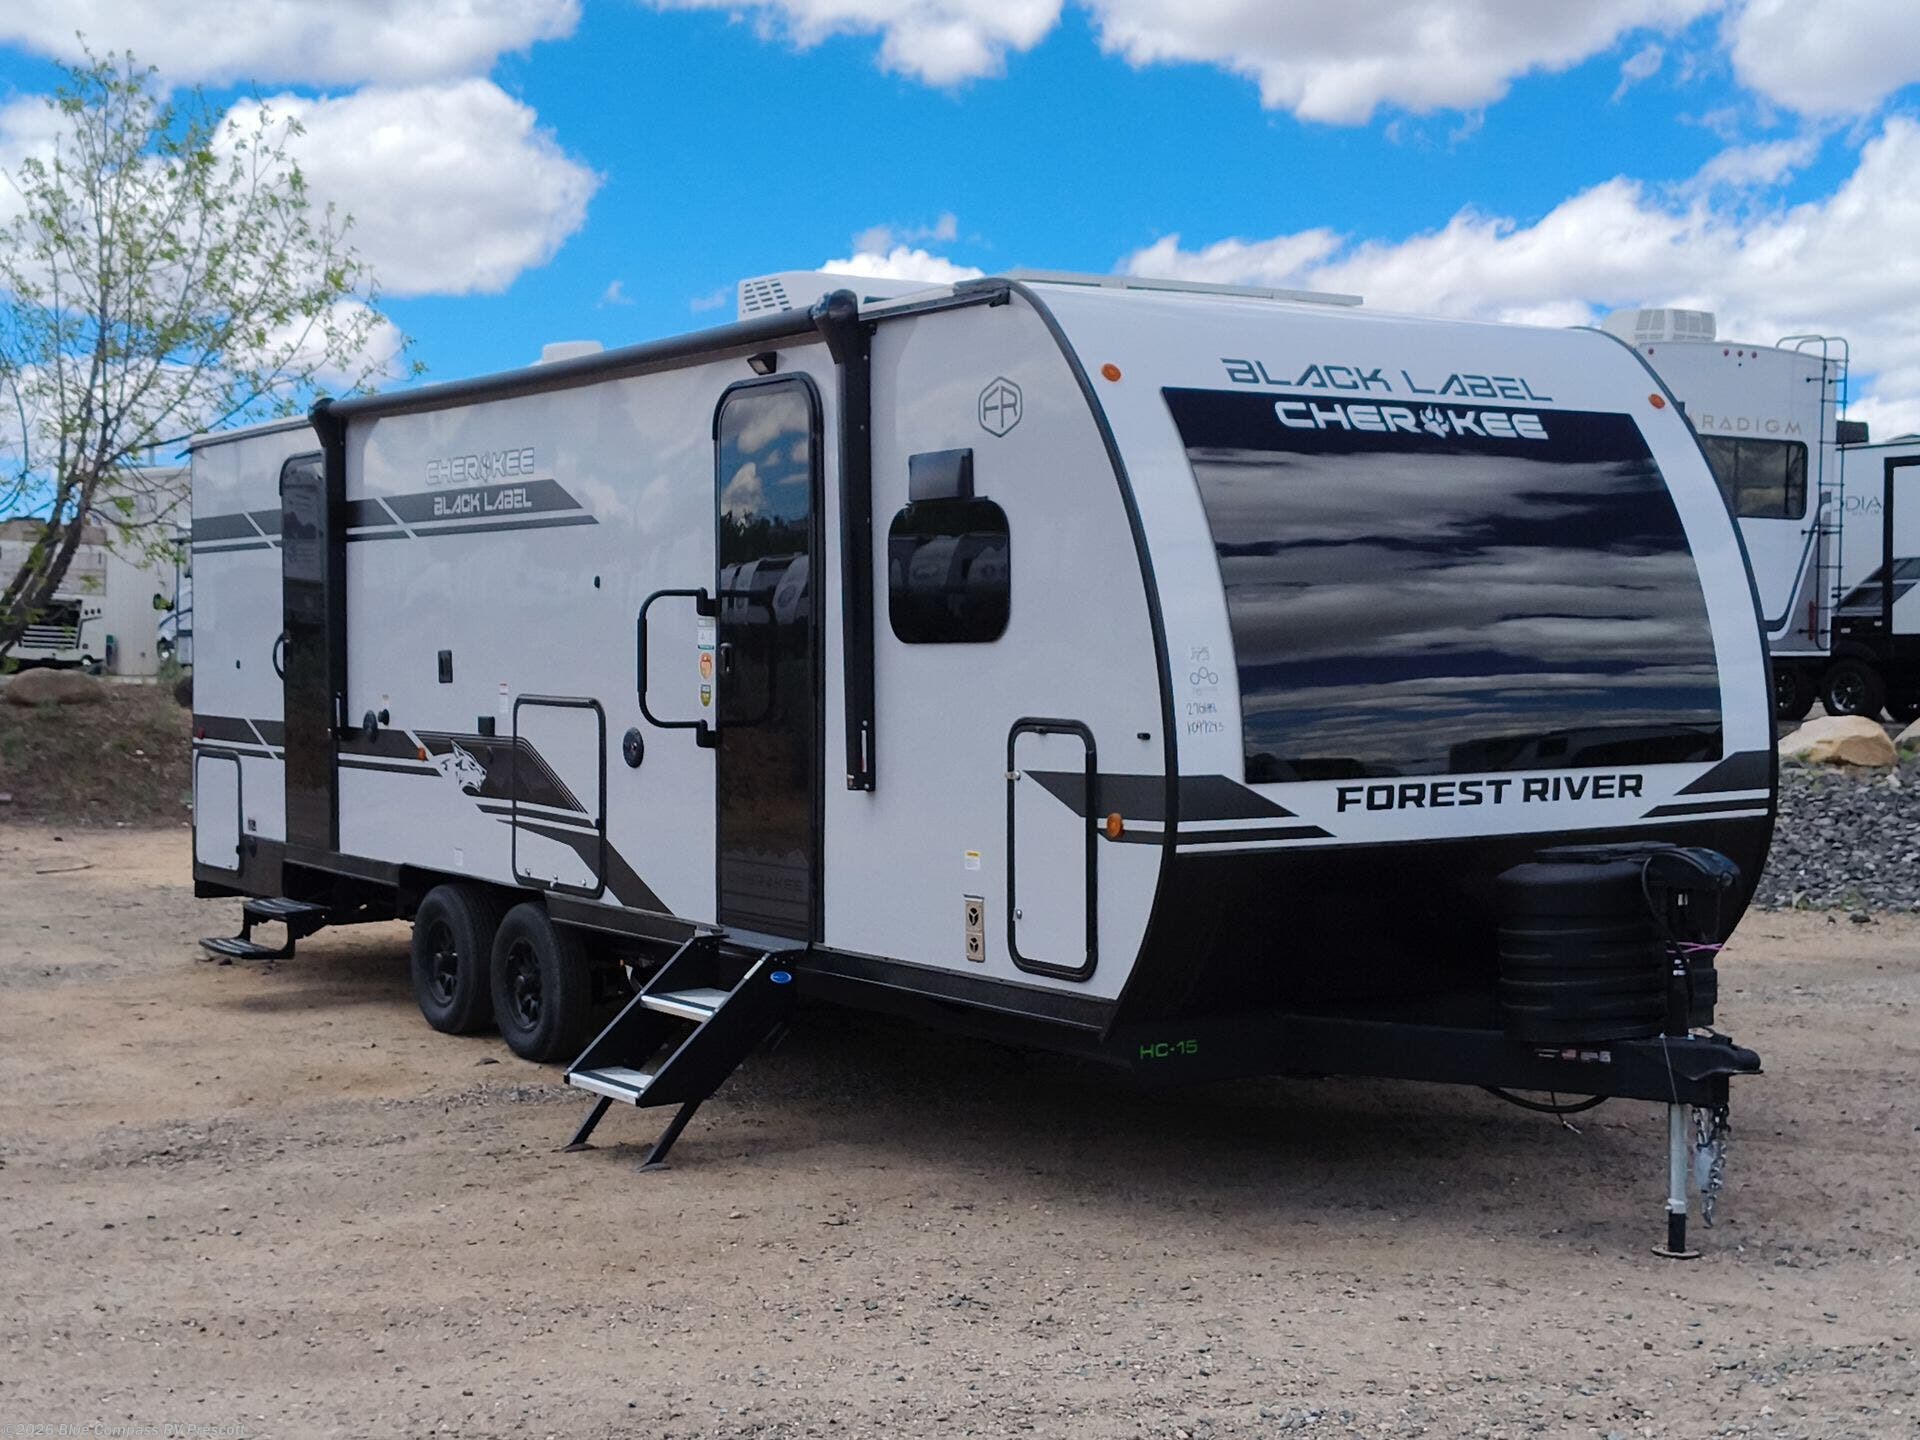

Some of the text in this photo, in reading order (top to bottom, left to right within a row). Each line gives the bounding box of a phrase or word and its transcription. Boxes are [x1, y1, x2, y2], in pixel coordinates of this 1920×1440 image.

[1220, 358, 1554, 402] BLACK LABEL
[1689, 412, 1802, 435] RADIGM
[434, 488, 532, 516] BLACK LABEL
[1337, 774, 1643, 812] FOREST RIVER
